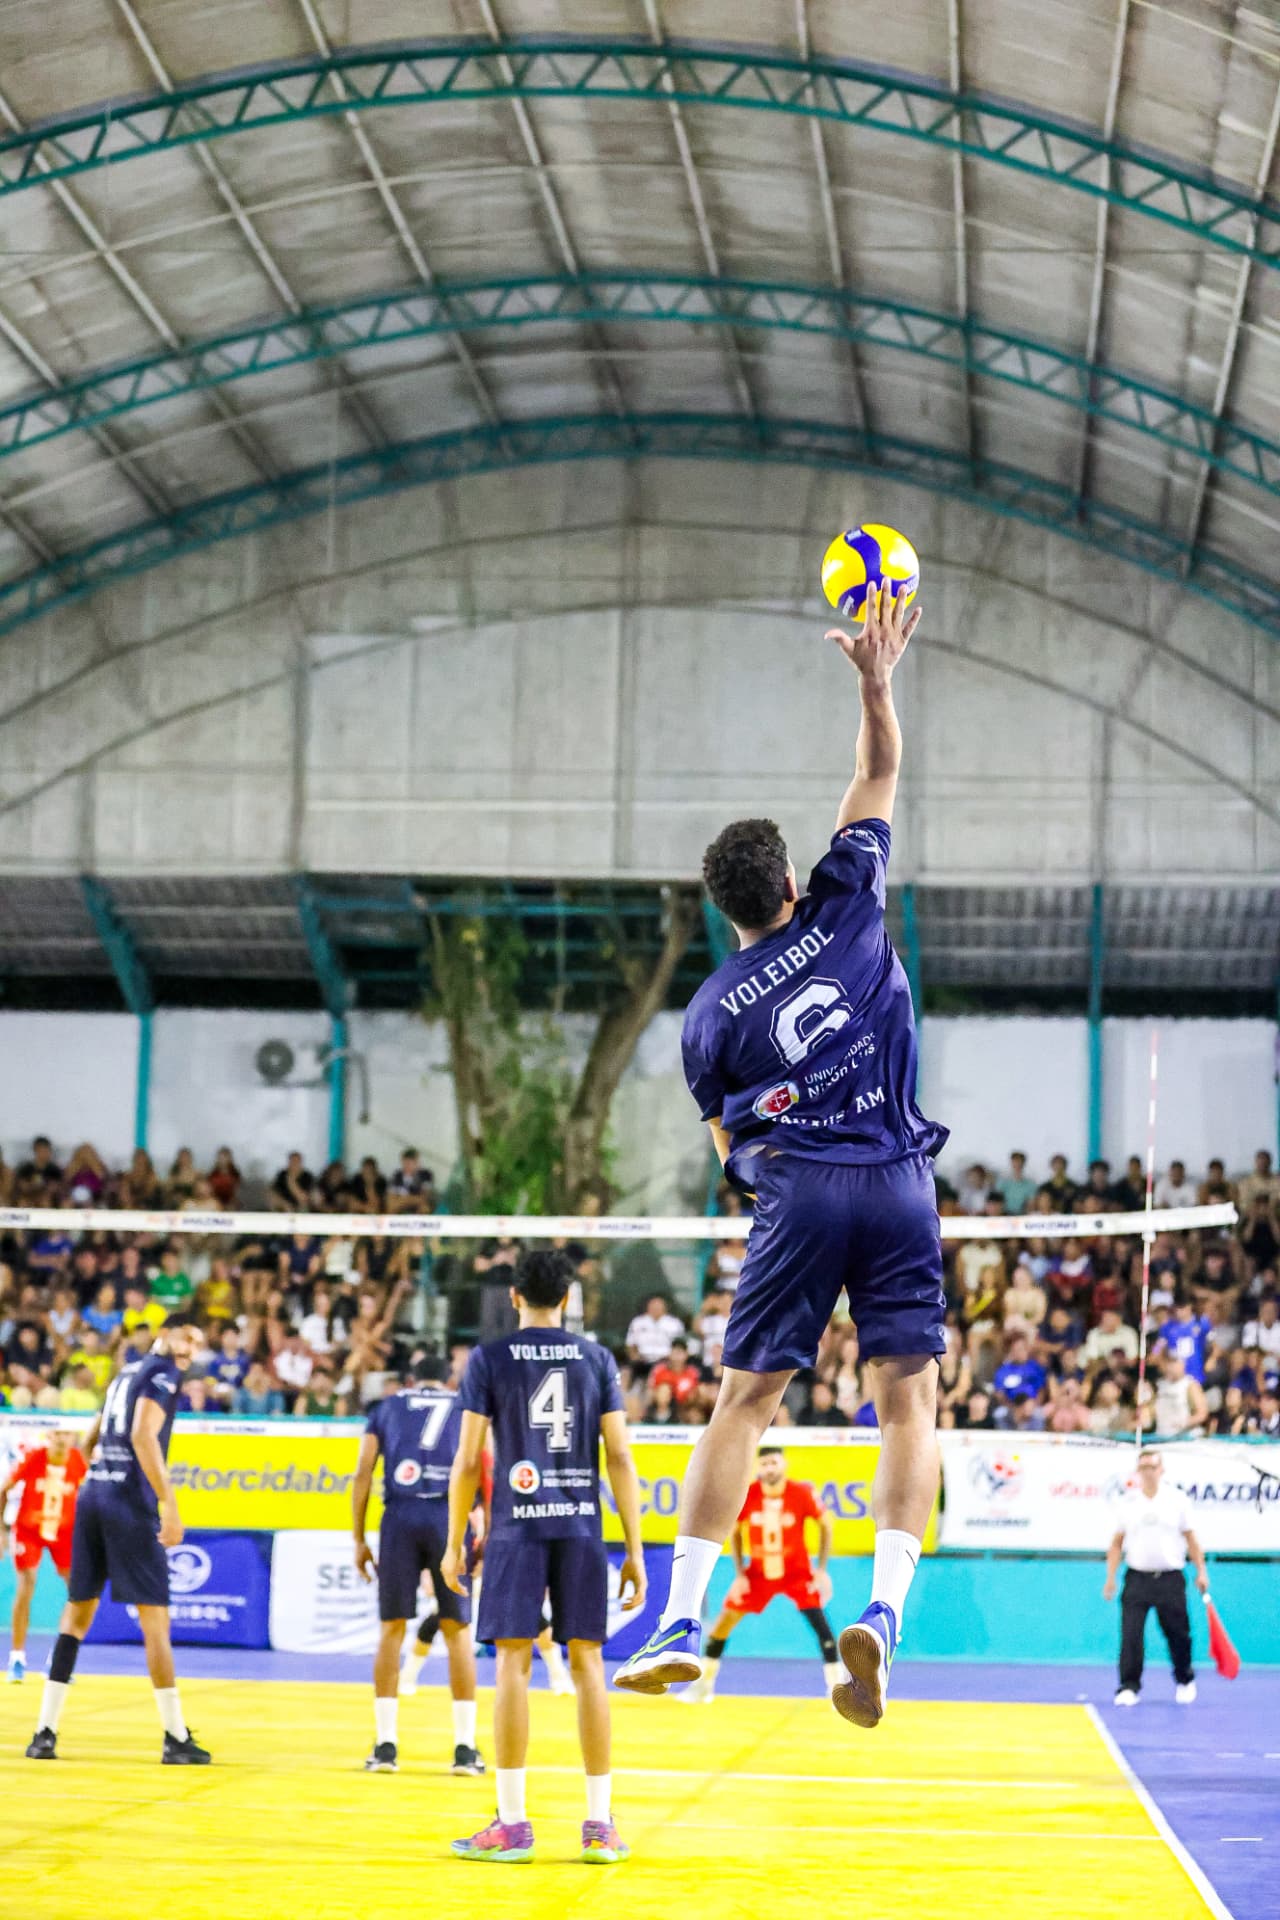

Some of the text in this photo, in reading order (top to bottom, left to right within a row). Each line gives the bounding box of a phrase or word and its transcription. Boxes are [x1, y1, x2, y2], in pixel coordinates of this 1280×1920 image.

[720, 926, 835, 1016] VOLEIBOL
[769, 976, 854, 1069] 6
[508, 1344, 584, 1361] VOLEIBOL
[100, 1377, 134, 1435] 14
[407, 1396, 452, 1451] 7
[527, 1367, 575, 1454] 4
